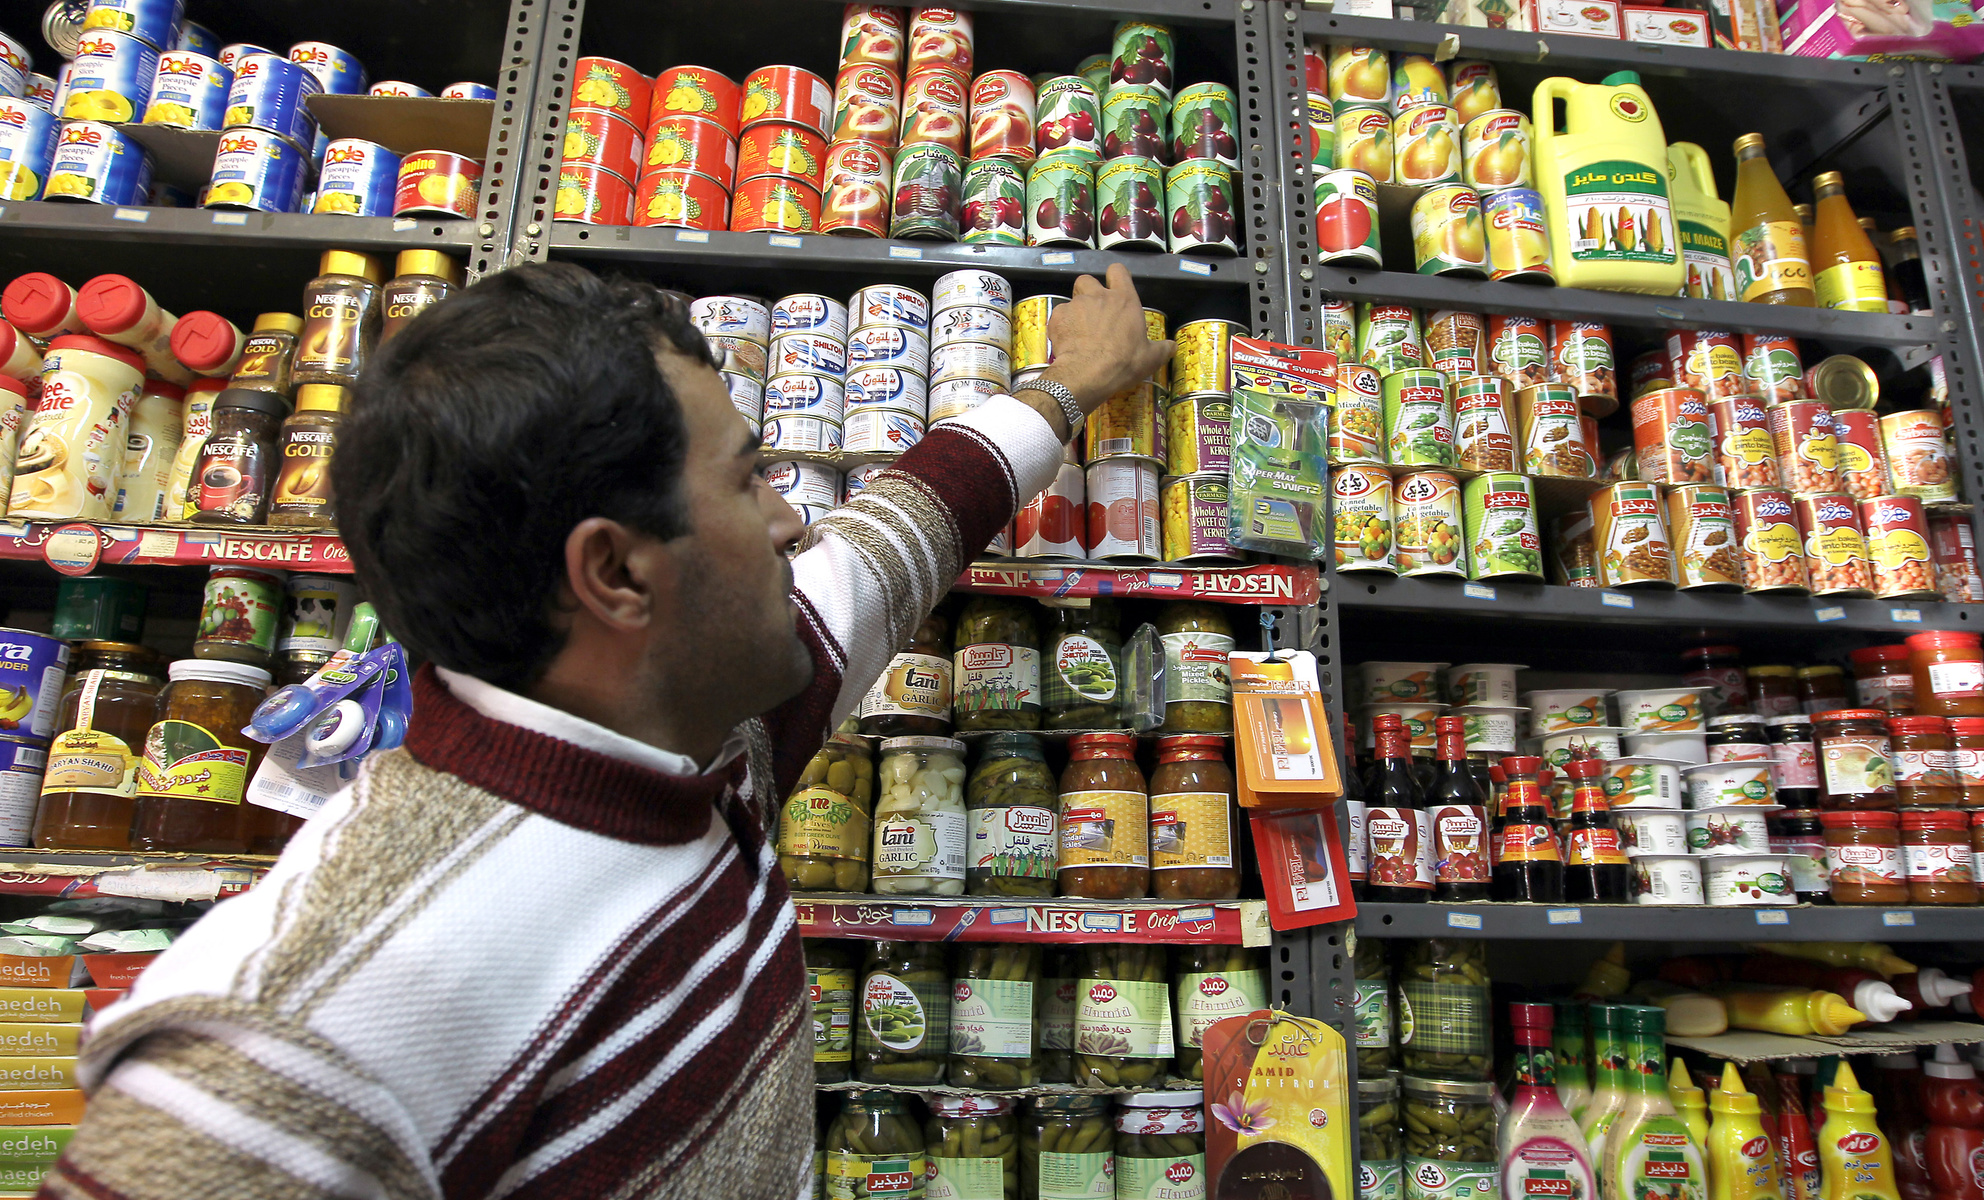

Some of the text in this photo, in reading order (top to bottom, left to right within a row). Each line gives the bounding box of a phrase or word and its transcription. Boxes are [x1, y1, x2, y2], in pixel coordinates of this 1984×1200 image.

[76, 37, 116, 56] Dole
[291, 47, 328, 64] Dole
[159, 56, 204, 77] Dole
[158, 76, 198, 88] Pineapple
[1041, 81, 1083, 99] خوشاب
[60, 126, 102, 145] Dole
[59, 147, 96, 157] Pineapple
[219, 135, 258, 155] Dole
[326, 146, 365, 165] Dole
[912, 147, 955, 165] خوشاب
[325, 165, 360, 175] Pineapple
[971, 164, 1014, 176] خوشاب
[1572, 171, 1658, 188] گلدن مایز
[1694, 234, 1724, 251] MAIZE
[896, 292, 926, 309] SHILTON
[308, 304, 360, 321] GOLD
[388, 305, 418, 319] GO
[245, 345, 277, 354] GOLD
[813, 340, 844, 356] SHILTON
[1518, 340, 1540, 350] baked
[1586, 344, 1607, 353] baked
[1234, 351, 1290, 371] SUPER-MAX
[1435, 358, 1473, 371] DELPAZIR
[1232, 364, 1278, 377] BONUS OFFER
[290, 432, 333, 444] NESCAFÉ
[1200, 425, 1219, 436] Whole
[1203, 436, 1223, 446] SWEET
[1734, 443, 1754, 452] pinto
[284, 443, 335, 458] GOLD
[1195, 507, 1216, 517] Whole
[1757, 500, 1793, 517] بهروز
[1818, 505, 1854, 521] بهروز
[1197, 518, 1217, 528] SWEET
[201, 537, 313, 562] NESCAFÉ
[1192, 572, 1294, 599] NESCAFÉ
[1062, 640, 1089, 652] شیلتون
[968, 647, 1006, 667] کامبیز
[1062, 651, 1090, 660] SHILTON
[905, 667, 940, 692] tani
[962, 671, 1014, 687] ترشی فلفل
[1182, 670, 1205, 678] Mixed
[1182, 677, 1211, 685] Pickles
[80, 670, 101, 728] DARYAN SHAHD
[82, 758, 114, 774] SHAHD
[1014, 809, 1050, 828] کامبیز
[1445, 818, 1478, 834] کامبیز
[1372, 821, 1405, 834] کامبیز
[881, 824, 916, 847] tani
[1004, 836, 1031, 850] فلفل
[878, 851, 918, 863] GARLIC
[868, 979, 893, 992] شیلتون
[1092, 985, 1114, 1000] حمید
[1203, 979, 1227, 994] حمید
[867, 991, 893, 1001] SHILTON
[1192, 996, 1245, 1011] Hamid
[1081, 1004, 1132, 1019] Hamid
[1281, 1029, 1324, 1045] زعفران
[1267, 1043, 1310, 1061] عمید
[0, 1065, 64, 1081] aedeh
[1255, 1066, 1295, 1077] AMID
[1168, 1164, 1194, 1180] حمید
[1647, 1163, 1686, 1177] دلپذیر
[870, 1173, 910, 1189] دلپذیر
[1529, 1180, 1568, 1193] دلپذیر
